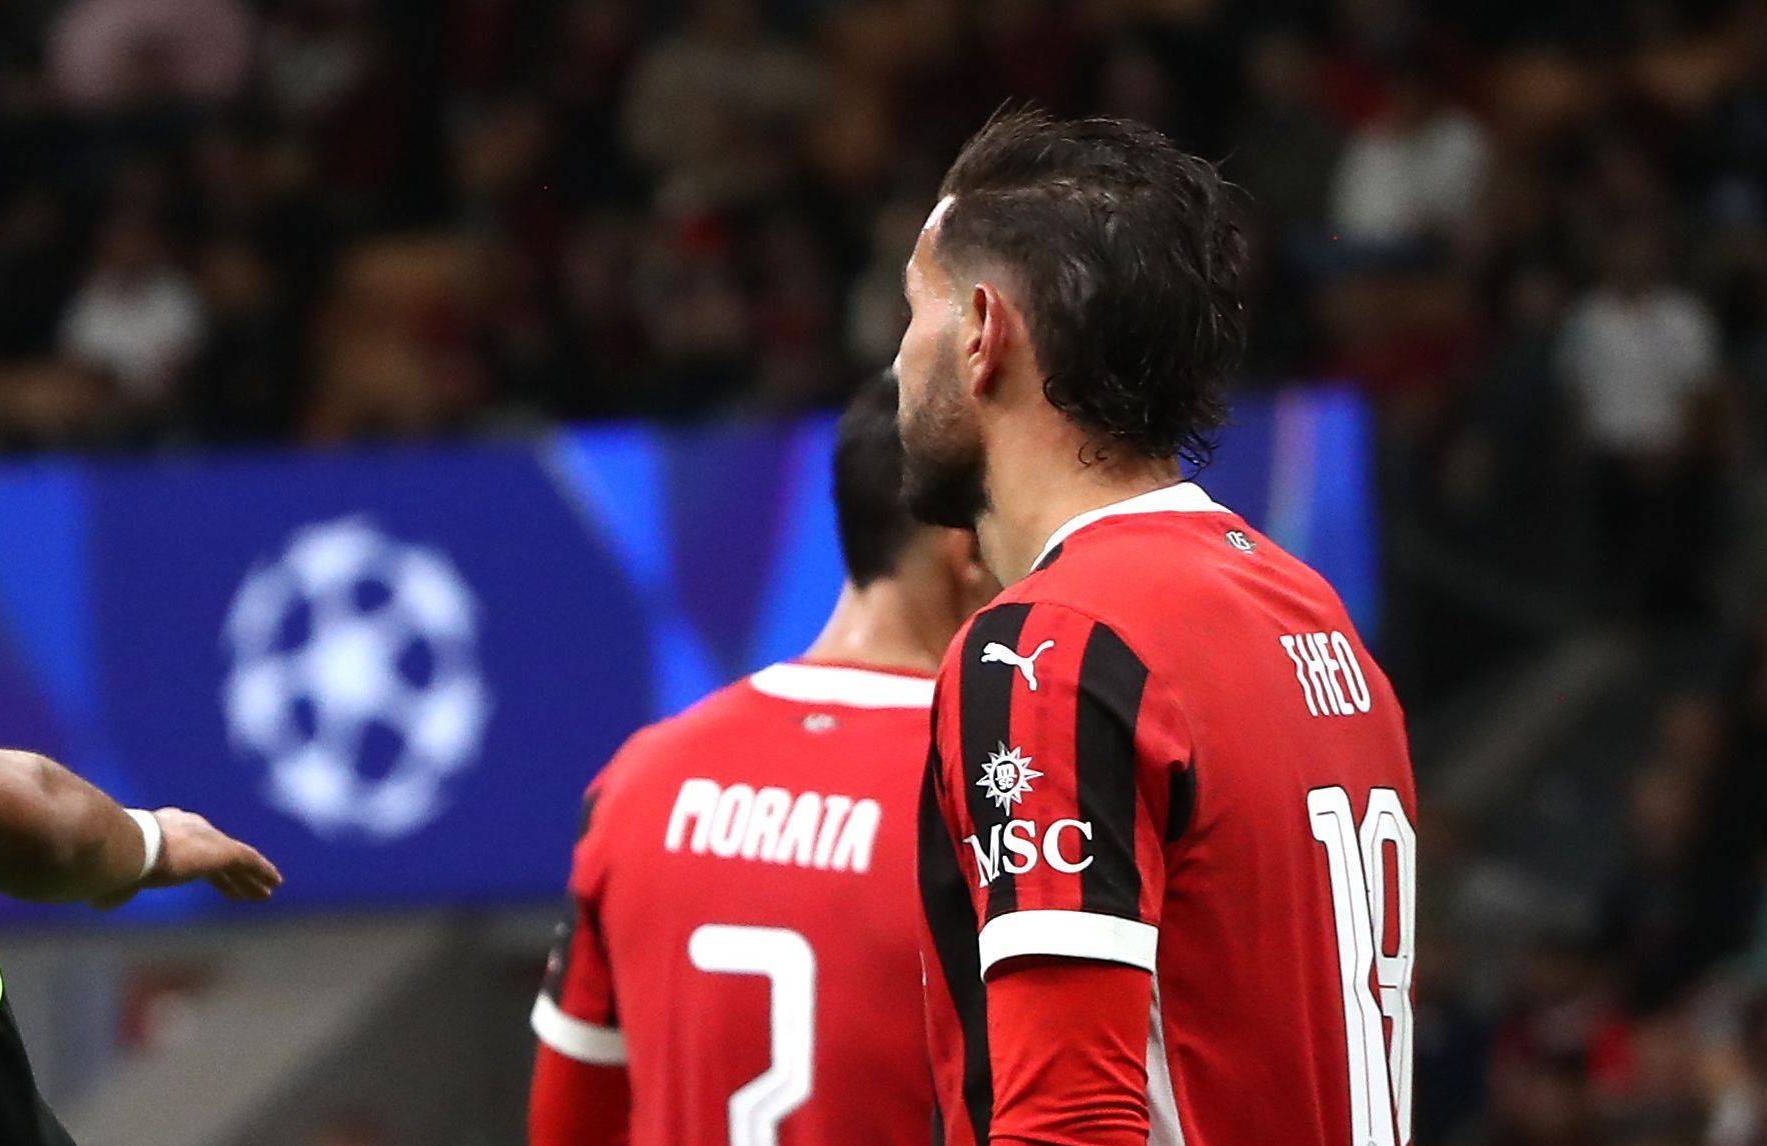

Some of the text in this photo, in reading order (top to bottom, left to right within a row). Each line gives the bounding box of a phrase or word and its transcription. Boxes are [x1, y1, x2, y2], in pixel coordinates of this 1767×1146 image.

[1279, 629, 1372, 717] THEO
[664, 778, 882, 874] MORATA
[963, 818, 1094, 888] MSC
